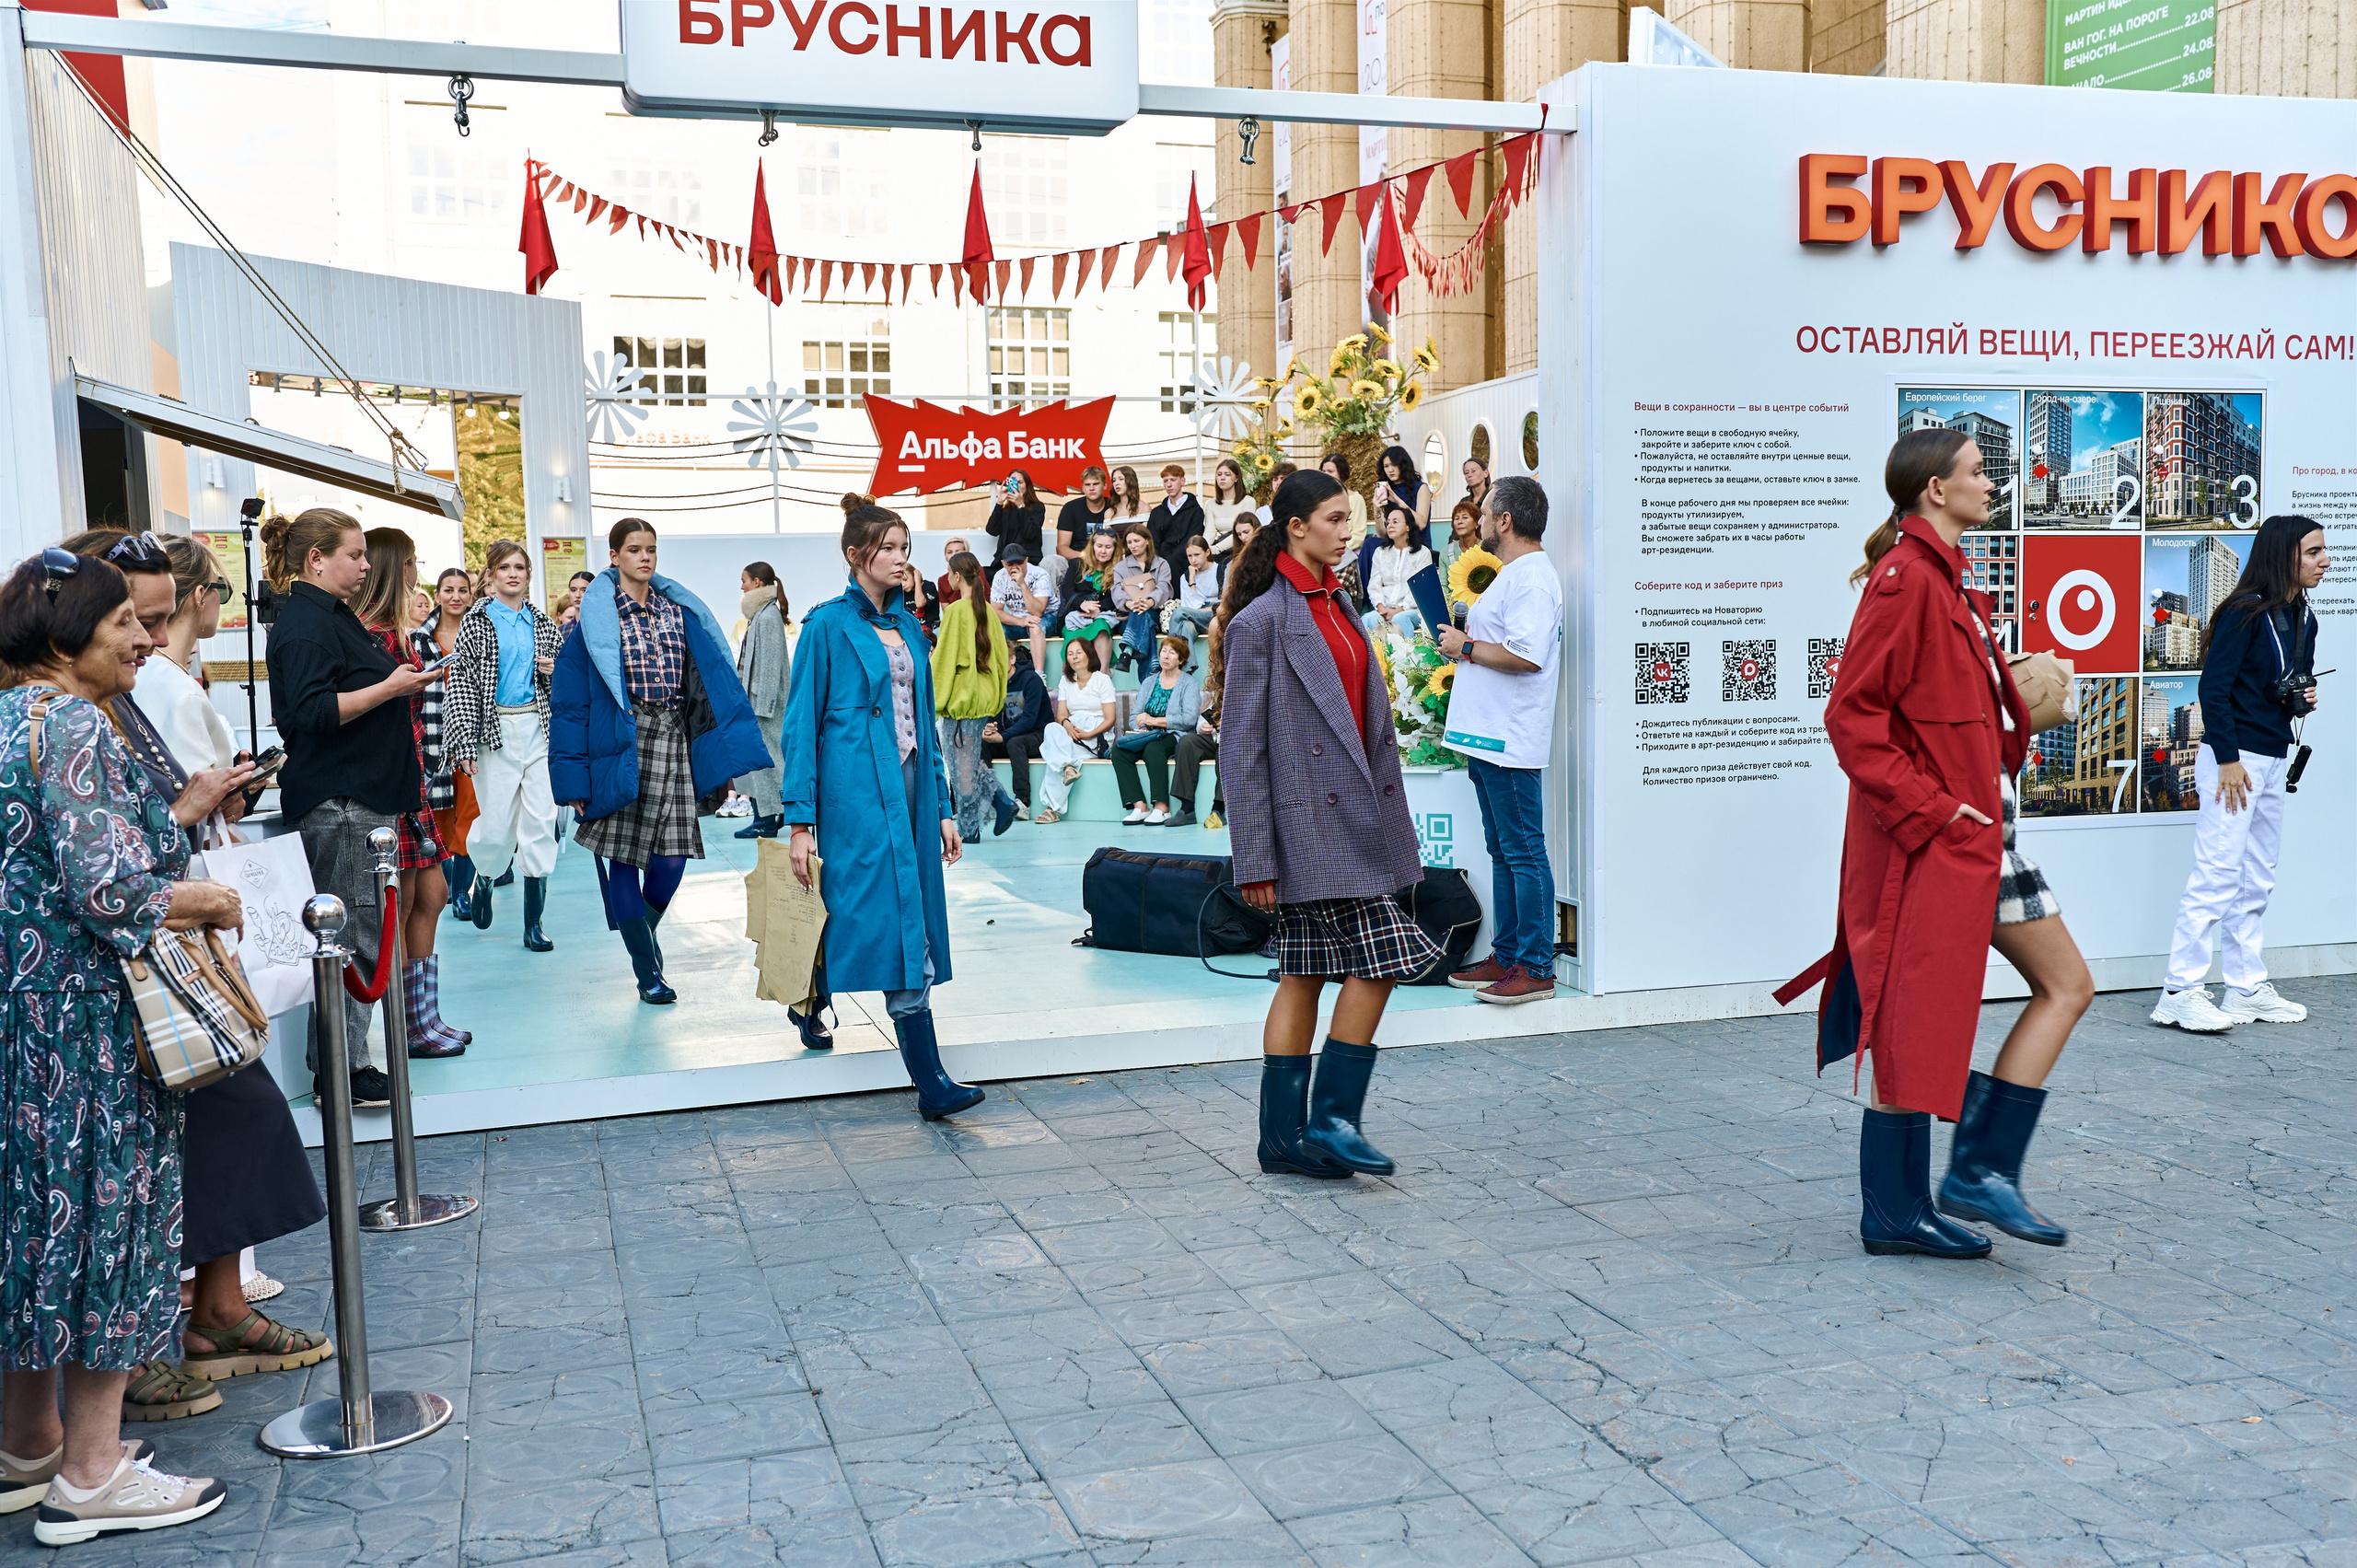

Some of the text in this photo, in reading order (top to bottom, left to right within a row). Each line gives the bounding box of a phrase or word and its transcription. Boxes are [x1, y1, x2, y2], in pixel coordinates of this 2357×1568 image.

[2064, 1, 2106, 27] МАРТИН
[2064, 37, 2085, 54] ВАН
[2086, 29, 2107, 46] ГОГ.
[2108, 23, 2123, 38] НА
[2126, 5, 2169, 31] ПОРОГЕ
[1799, 154, 2357, 260] БРУСНИКО
[1795, 321, 2354, 361] ОСТАВЛЯЙ ВЕЩИ, ПЕРЕЕЗЖАЙ САМ!
[1905, 392, 1987, 403] Европейский берег
[2032, 393, 2096, 404] Город-на-озере
[2154, 397, 2190, 406] Пшеница
[1634, 401, 1662, 412] Вещи
[1672, 404, 1736, 413] сохранности
[1772, 404, 1806, 413] центре
[1808, 402, 1849, 412] событий
[1640, 428, 1685, 437] Положите
[1686, 430, 1710, 438] вещи
[1718, 428, 1767, 438] свободную
[1768, 428, 1799, 438] ячейку,
[898, 431, 1086, 469] Альфа Банк
[1641, 439, 1682, 450] закройте
[1690, 440, 1731, 450] заберите
[1763, 440, 1792, 448] собой.
[1640, 451, 1696, 462] Пожалуйста,
[1710, 451, 1759, 460] оставляйте
[1761, 453, 1791, 462] внутри
[1793, 453, 1825, 461] ценные
[1827, 453, 1851, 461] вещи,
[1642, 465, 1684, 474] продукты
[2293, 466, 2309, 476] Про
[2311, 468, 2339, 476] город,
[1640, 475, 1666, 485] Когда
[1667, 477, 1713, 485] вернетесь
[2292, 490, 2328, 499] Брусника
[1642, 498, 1648, 507] В
[1650, 500, 1677, 508] конце
[1678, 498, 1718, 509] рабочего
[1719, 500, 1736, 508] дня
[1753, 499, 1799, 508] проверяем
[1817, 497, 1849, 506] ячейки:
[2000, 475, 2018, 529] 1
[2109, 475, 2141, 529] 2
[2230, 475, 2259, 529] 3
[1642, 511, 1745, 521] продукты утилизируем,
[1648, 522, 1687, 531] забытые
[1689, 523, 1712, 531] вещи
[1713, 523, 1759, 531] сохраняем
[1760, 523, 1767, 531] у
[1768, 522, 1840, 530] администратора.
[1642, 534, 1655, 542] Вы
[1696, 533, 1730, 543] забрать
[1774, 532, 1805, 542] работы
[2152, 538, 2197, 548] Молодость
[1641, 547, 1714, 556] арт-резиденции.
[1634, 581, 1682, 592] Соберите
[1684, 582, 1702, 591] код
[1713, 579, 1758, 591] заберите
[1760, 581, 1783, 590] приз
[2316, 598, 2355, 606] переехать
[1641, 607, 1701, 617] Подпишитесь
[1714, 606, 1763, 615] Новаторию
[1649, 618, 1689, 627] любимой
[1690, 617, 1743, 627] социальной
[2150, 680, 2184, 690] Авиатор
[1641, 719, 1690, 730] Дождитесь
[1692, 717, 1744, 728] публикации
[1752, 716, 1800, 726] вопросами.
[1641, 731, 1680, 740] Ответьте
[1695, 728, 1729, 738] каждый
[1738, 726, 1778, 737] соберите
[1642, 743, 1689, 753] Приходите
[1698, 739, 1770, 750] арт-резиденцию
[1778, 737, 1821, 747] забирайте
[1642, 760, 1812, 776] Для каждого приза действует свой код.
[1643, 773, 1780, 786] Количество призов ограничено.
[2107, 759, 2137, 813] 7
